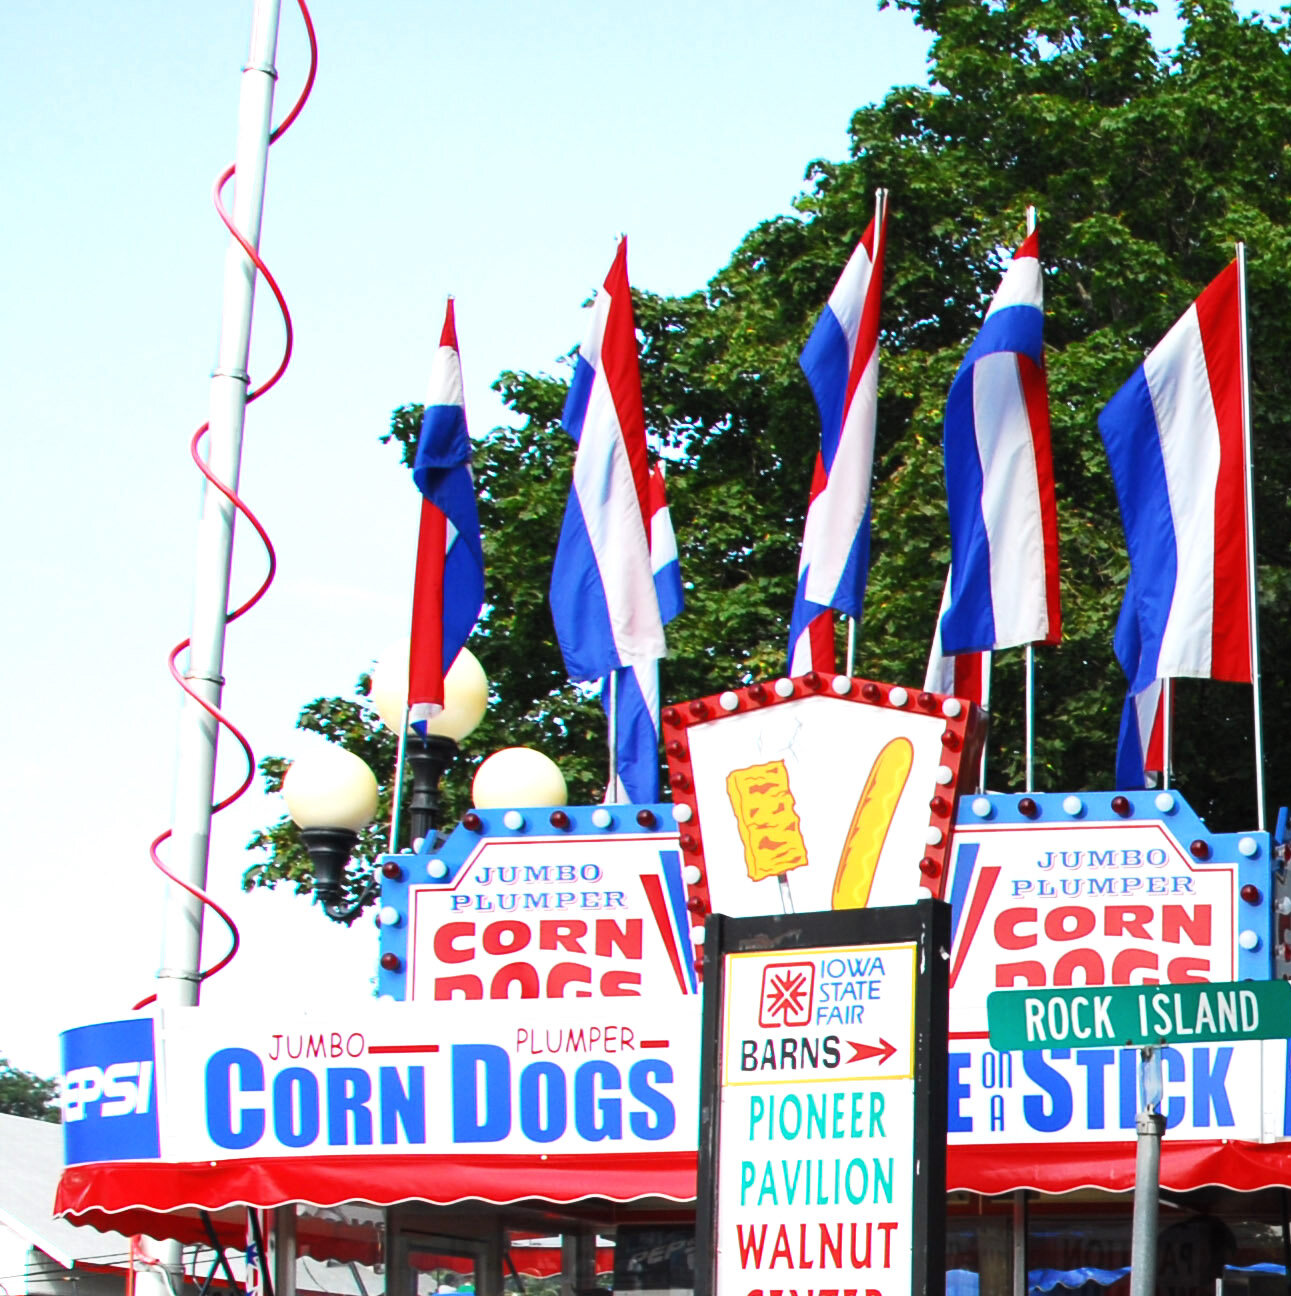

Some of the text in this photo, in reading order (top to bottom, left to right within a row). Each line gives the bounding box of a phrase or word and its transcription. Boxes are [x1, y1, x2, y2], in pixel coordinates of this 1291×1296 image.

[476, 864, 603, 885] JUMBO
[1037, 848, 1169, 869] JUMBO
[450, 891, 627, 912] PLUMPER
[1011, 876, 1195, 898] PLUMPER
[434, 919, 643, 964] CORN
[994, 904, 1212, 950] CORN
[820, 957, 885, 979] IOWA
[819, 980, 881, 1003] STATE
[816, 1004, 865, 1026] FAIR
[1025, 990, 1259, 1042] ROCK ISLAND
[269, 1033, 365, 1061] JUMBO
[517, 1026, 635, 1055] PLUMPER
[741, 1035, 841, 1072] BARNS
[62, 1060, 154, 1123] EPSI
[205, 1044, 677, 1150] CORN DOGS
[749, 1091, 887, 1141] PIONEER
[990, 1095, 1005, 1131] A
[740, 1157, 895, 1206] PAVILION
[736, 1221, 899, 1270] WALNUT
